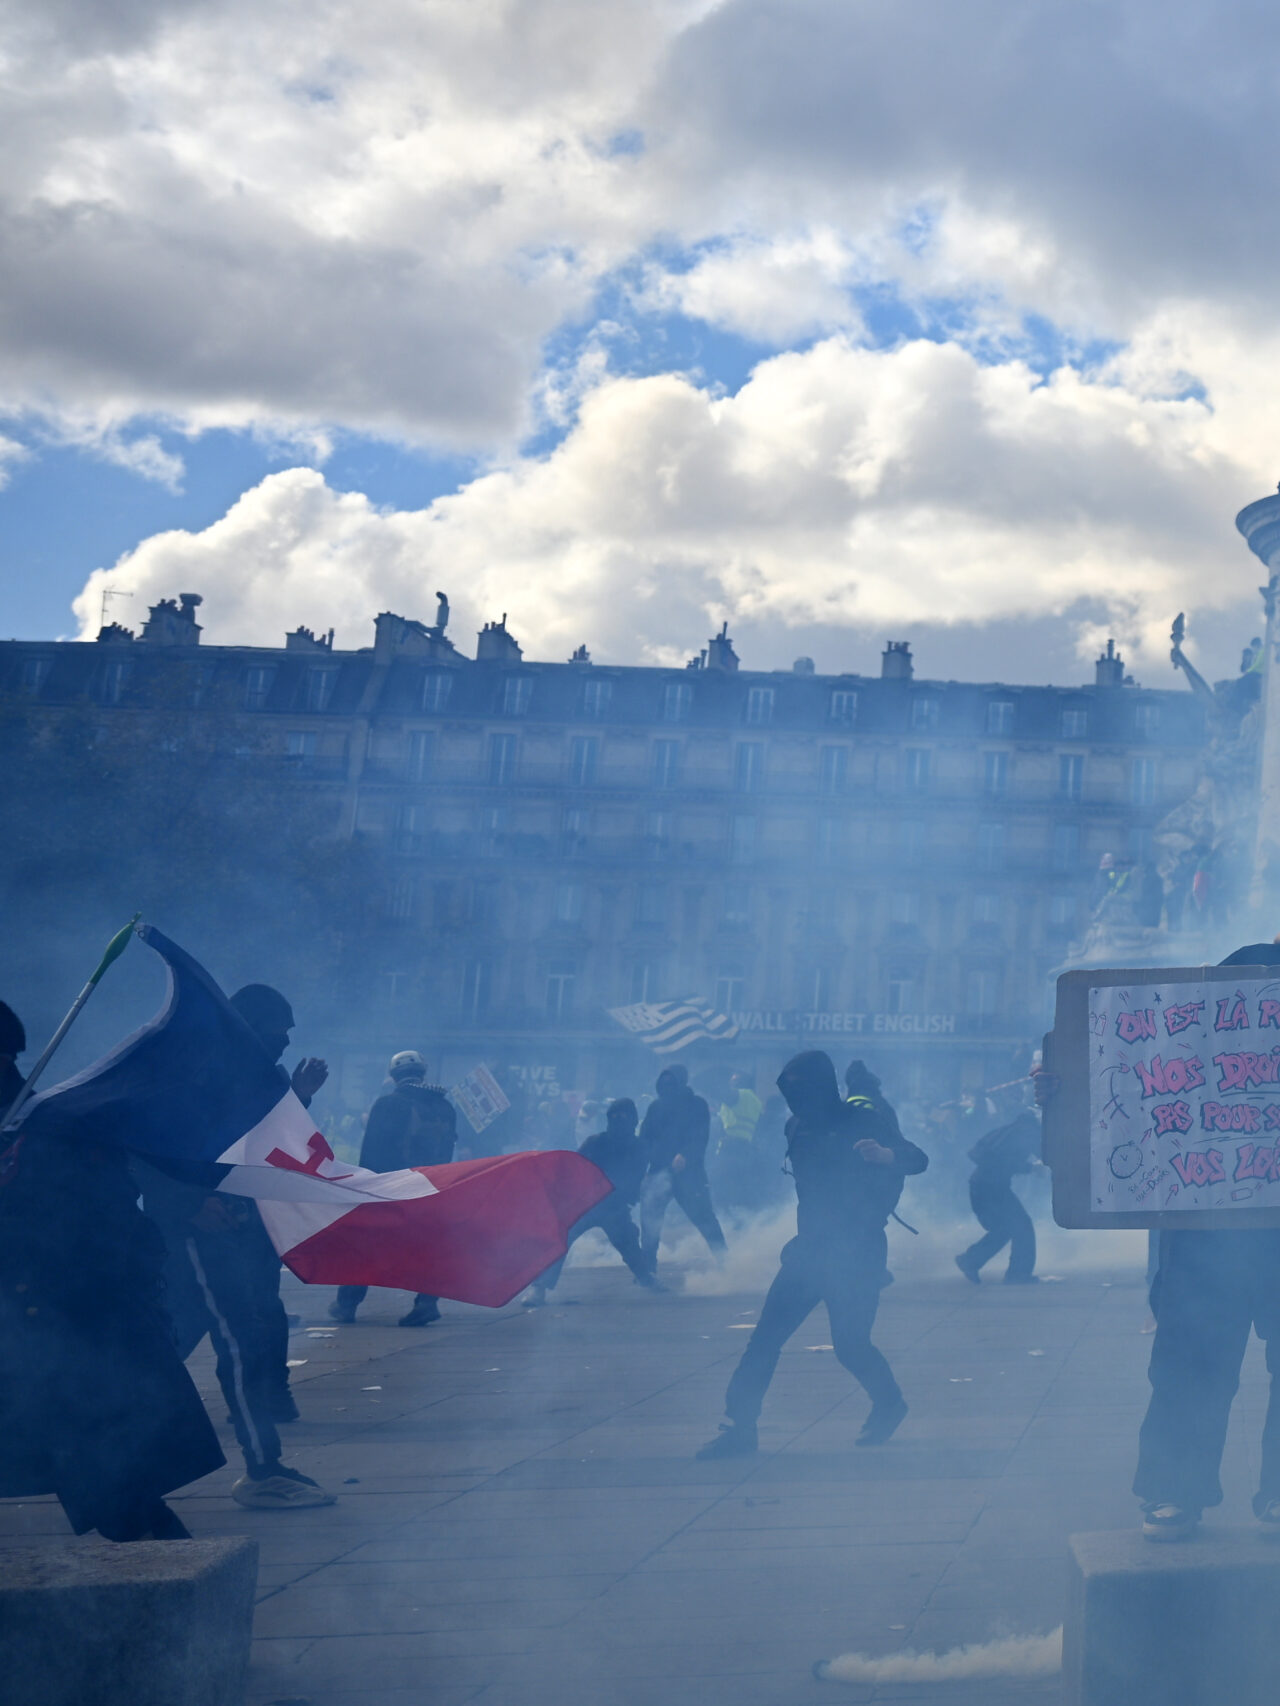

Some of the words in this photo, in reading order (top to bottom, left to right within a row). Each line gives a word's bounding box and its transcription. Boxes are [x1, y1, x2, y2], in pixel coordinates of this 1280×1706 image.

[731, 1011, 787, 1031] WALL
[873, 1013, 956, 1033] ENGLISH
[1115, 1008, 1158, 1045] ON
[1163, 1000, 1205, 1037] EST
[1214, 989, 1250, 1032] LÀ
[517, 1081, 561, 1097] YS
[1133, 1053, 1206, 1100] NOS
[1151, 1099, 1194, 1138] PAS
[1200, 1101, 1262, 1134] POUR
[1168, 1148, 1226, 1189] VOS
